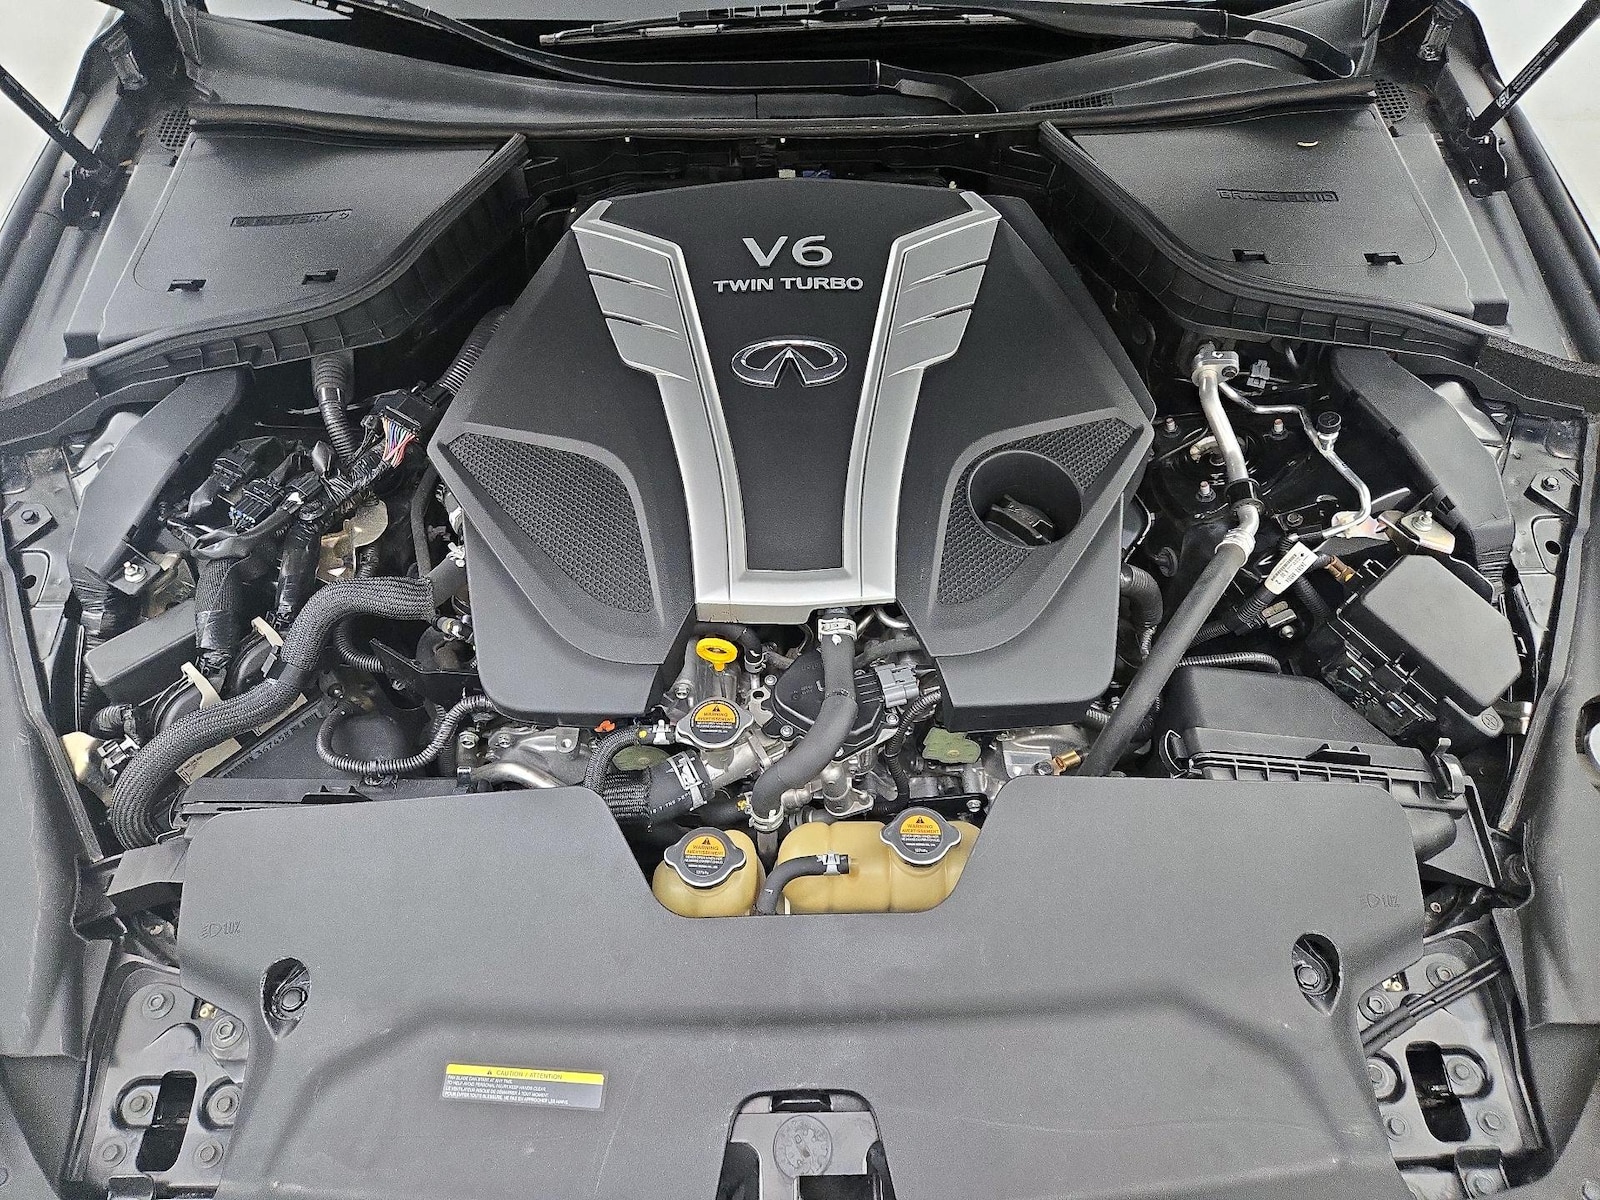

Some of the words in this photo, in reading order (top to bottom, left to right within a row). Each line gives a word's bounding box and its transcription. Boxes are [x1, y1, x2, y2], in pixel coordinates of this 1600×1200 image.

[742, 235, 833, 268] V6
[713, 278, 774, 293] TWIN
[780, 277, 864, 291] TURBO
